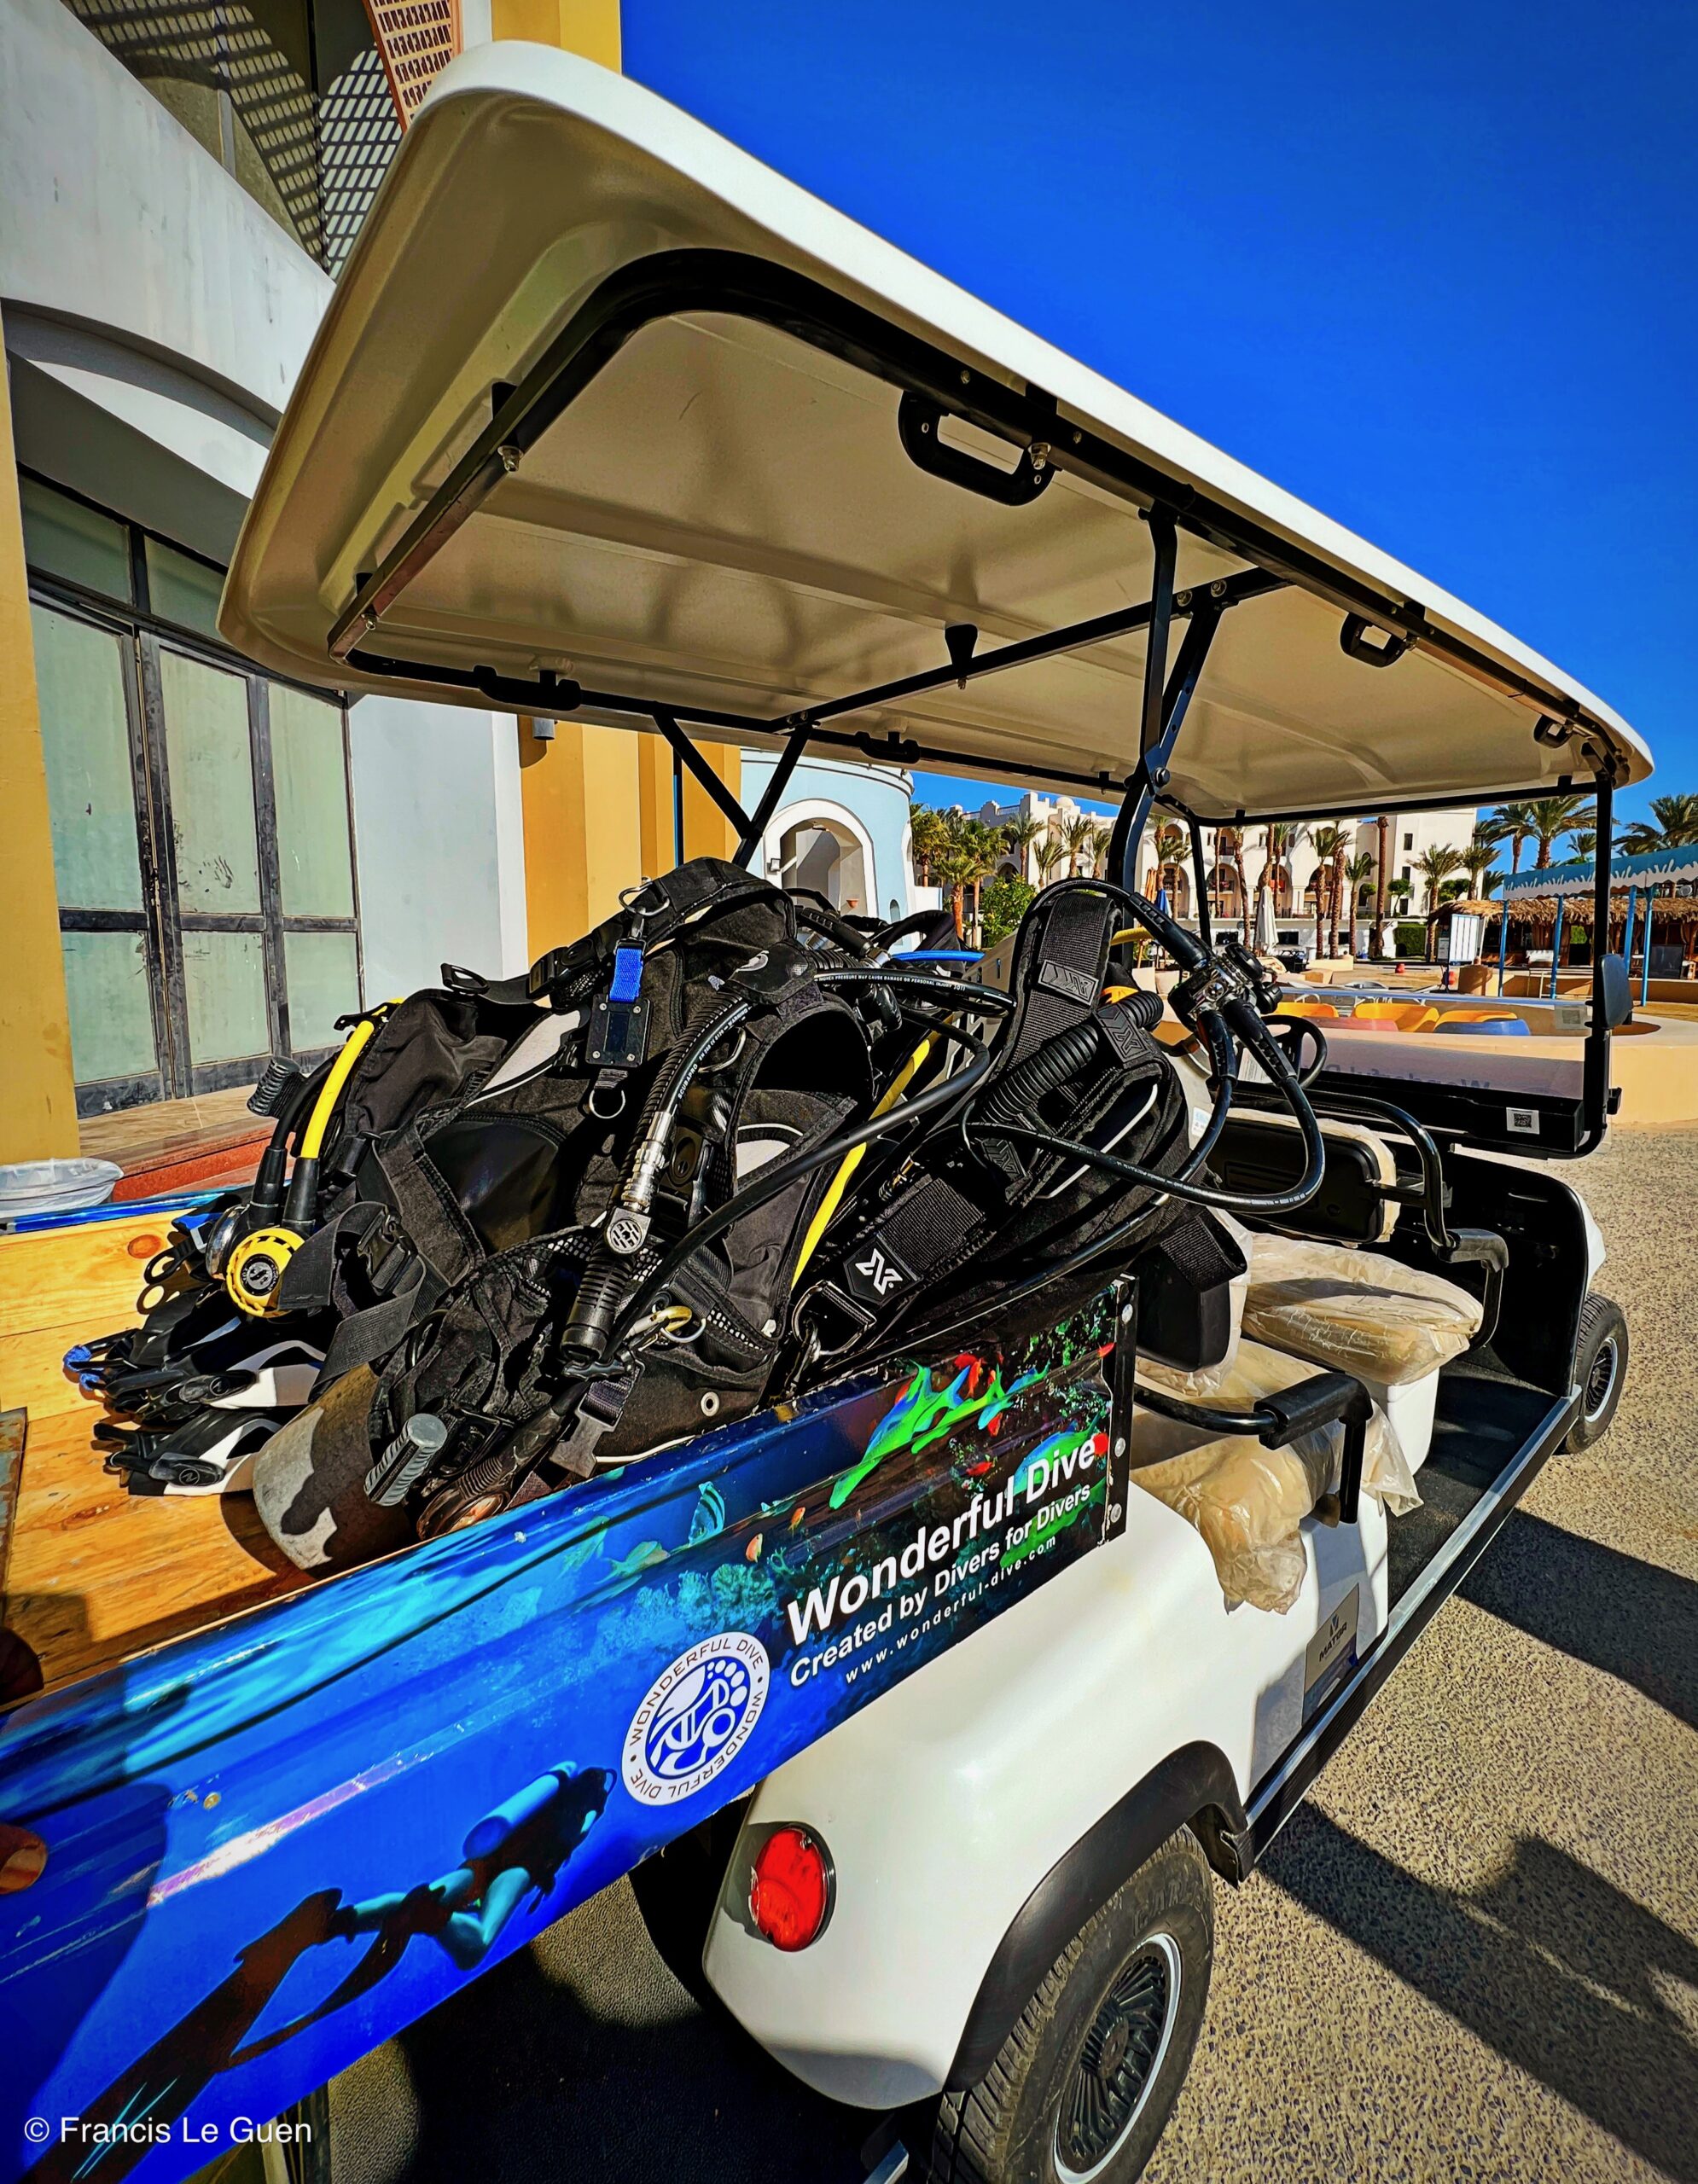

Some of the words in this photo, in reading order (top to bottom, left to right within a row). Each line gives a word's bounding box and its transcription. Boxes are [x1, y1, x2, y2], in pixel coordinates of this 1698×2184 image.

[911, 977, 934, 986] PERSONAL
[677, 1063, 698, 1100] SCUBAPRO
[787, 1474, 1014, 1647] Wonderful
[1026, 1438, 1095, 1504] Dive
[790, 1604, 892, 1687] Created
[899, 1587, 928, 1620] by
[934, 1541, 1000, 1598] Divers
[1005, 1520, 1033, 1551] for
[1036, 1484, 1090, 1532] Divers
[845, 1535, 1056, 1684] www.wonderful-dive.com
[630, 1637, 731, 1746] WONDERFUL
[736, 1638, 764, 1670] DIVE
[667, 1690, 765, 1798] WONDERFUL
[630, 1769, 662, 1799] DIVE
